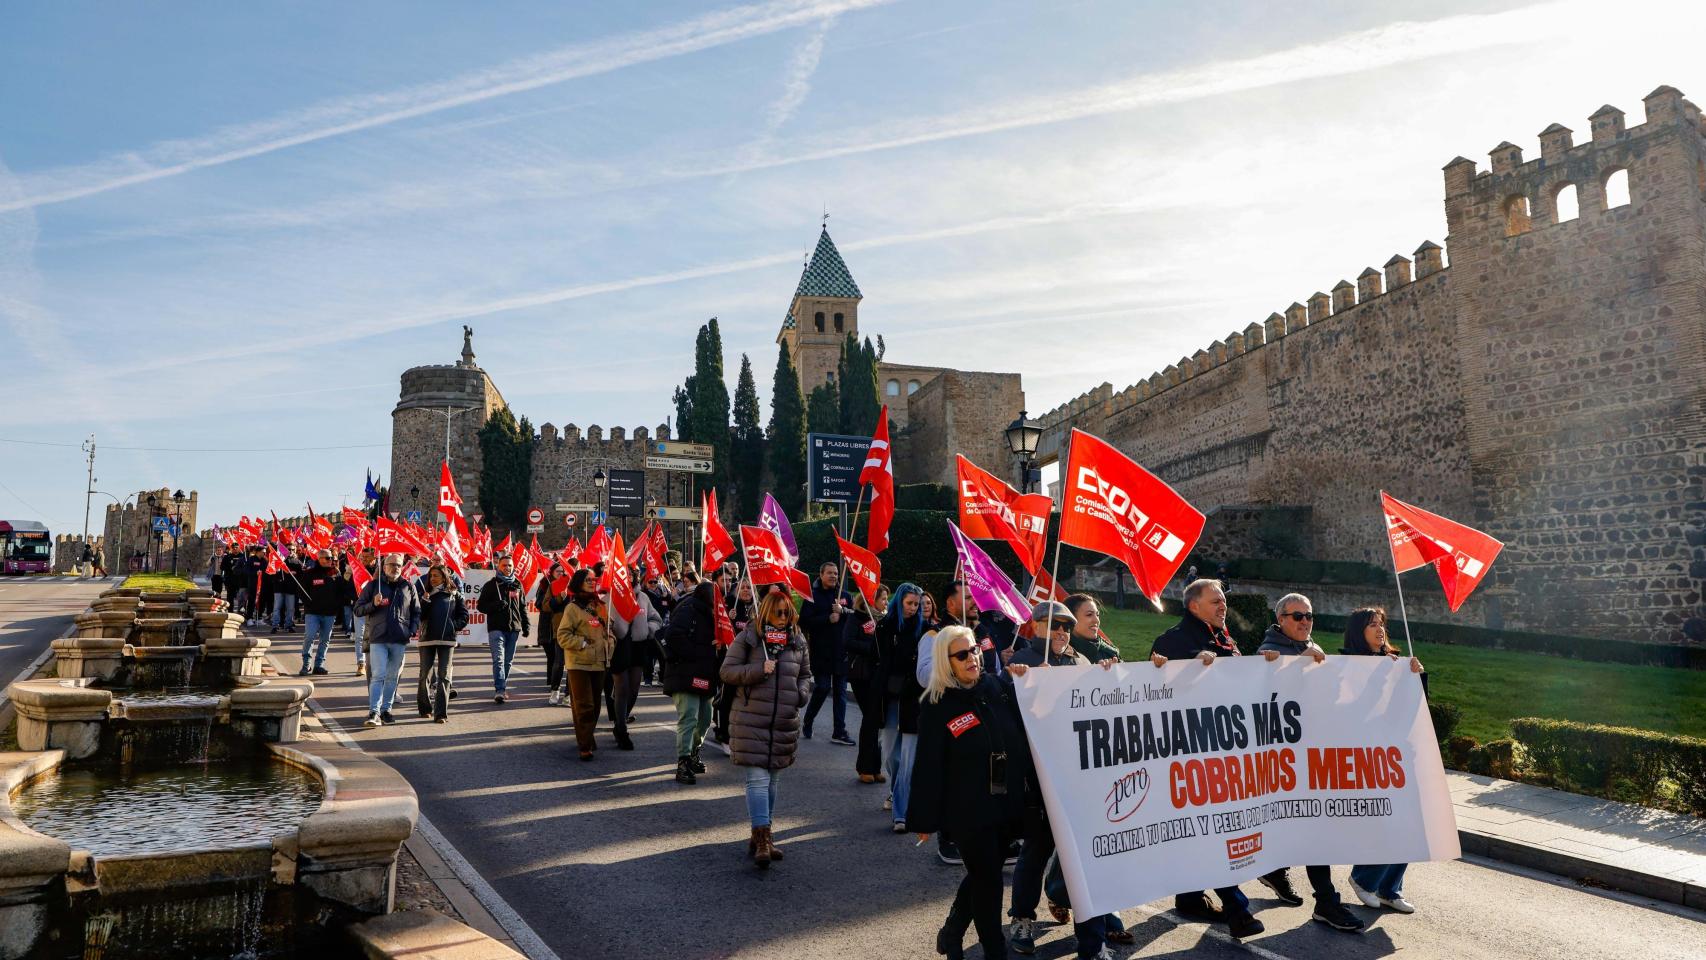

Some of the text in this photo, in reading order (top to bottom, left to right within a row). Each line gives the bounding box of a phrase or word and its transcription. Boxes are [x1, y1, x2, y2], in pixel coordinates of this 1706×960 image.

[1074, 505, 1085, 514] de
[1070, 689, 1085, 708] En
[1142, 683, 1173, 702] Mancha
[949, 713, 974, 731] CCOO
[1073, 692, 1302, 770] TRABAJAMOS MÁS
[1113, 746, 1406, 815] pero COBRAMOS MENOS
[1092, 798, 1392, 858] ORGANIZA TU RABIA Y PELEA POR TU CONVENIO COLECTIVO
[1230, 838, 1254, 855] CCOO
